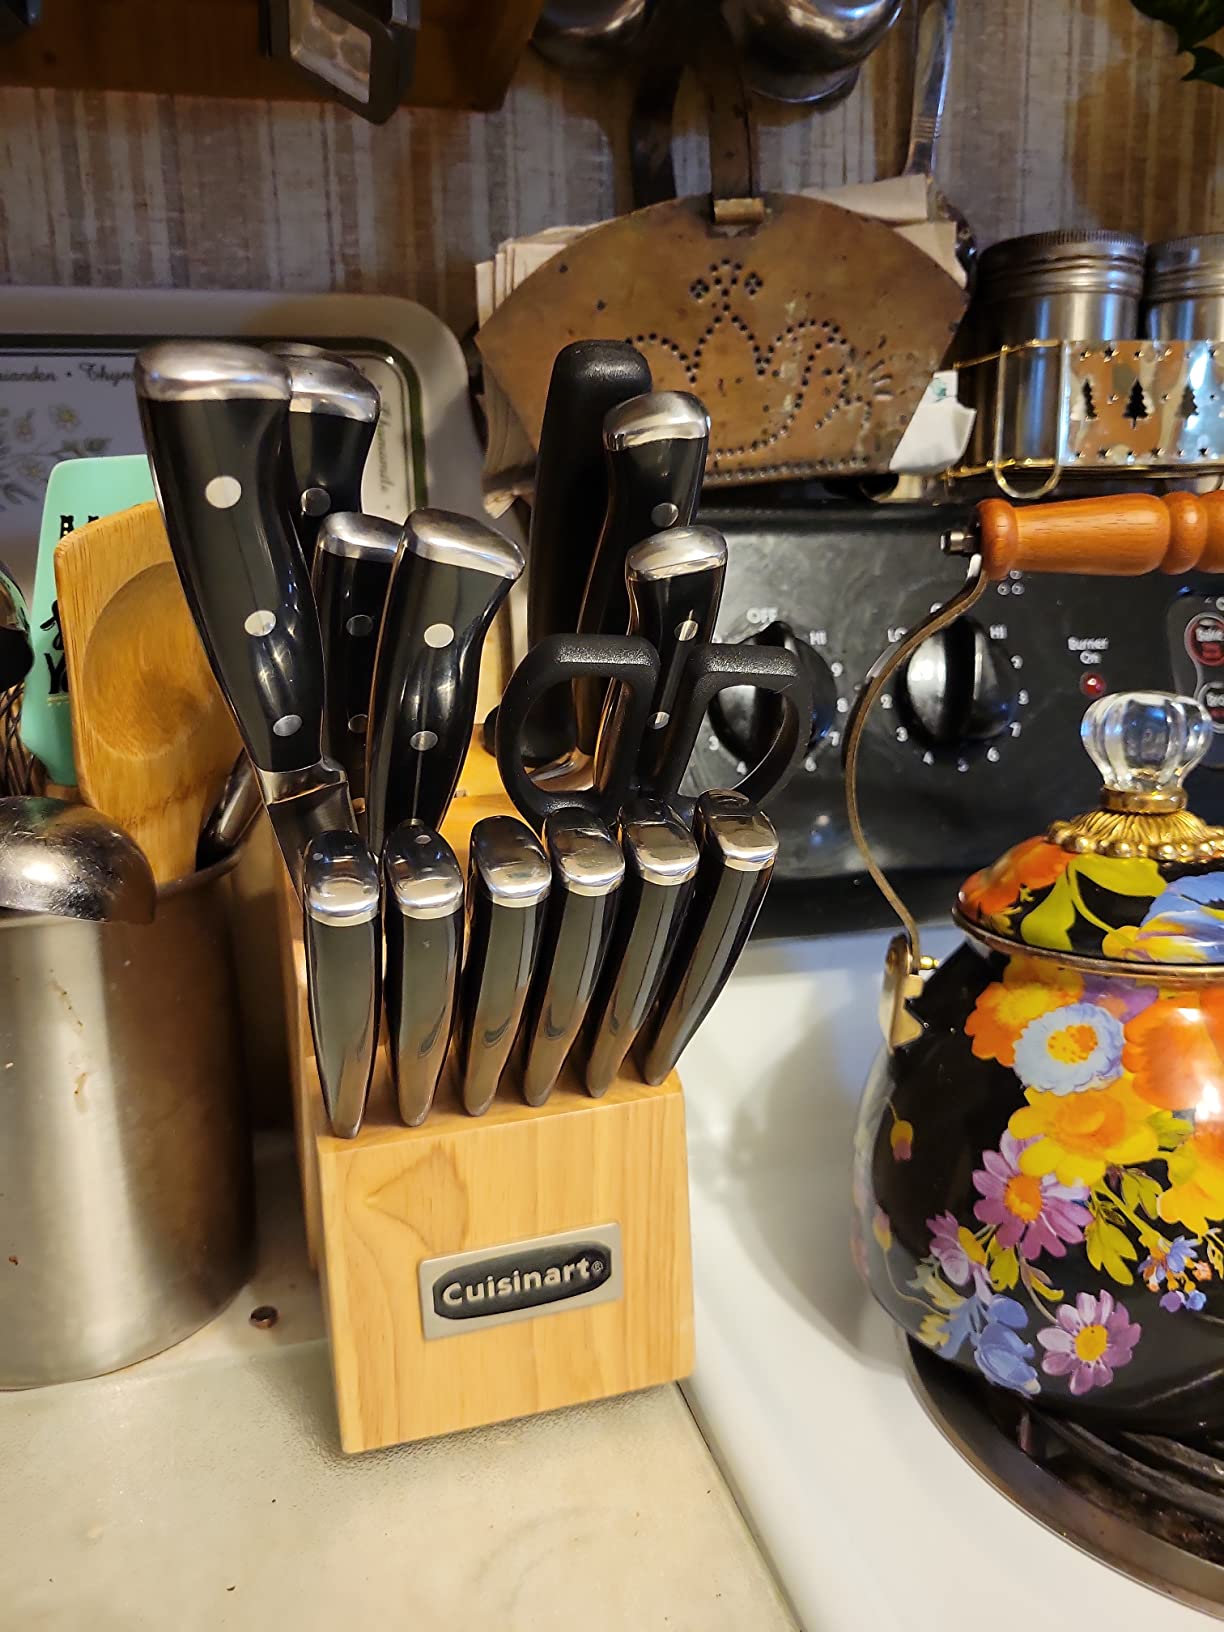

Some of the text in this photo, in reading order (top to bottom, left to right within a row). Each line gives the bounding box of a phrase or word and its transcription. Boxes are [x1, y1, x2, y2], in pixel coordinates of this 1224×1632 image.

[746, 607, 778, 623] OFF
[809, 630, 827, 645] HI
[880, 693, 893, 709] 2
[829, 730, 841, 746] 7
[896, 726, 909, 742] 3
[708, 735, 720, 751] 3
[805, 756, 817, 772] 6
